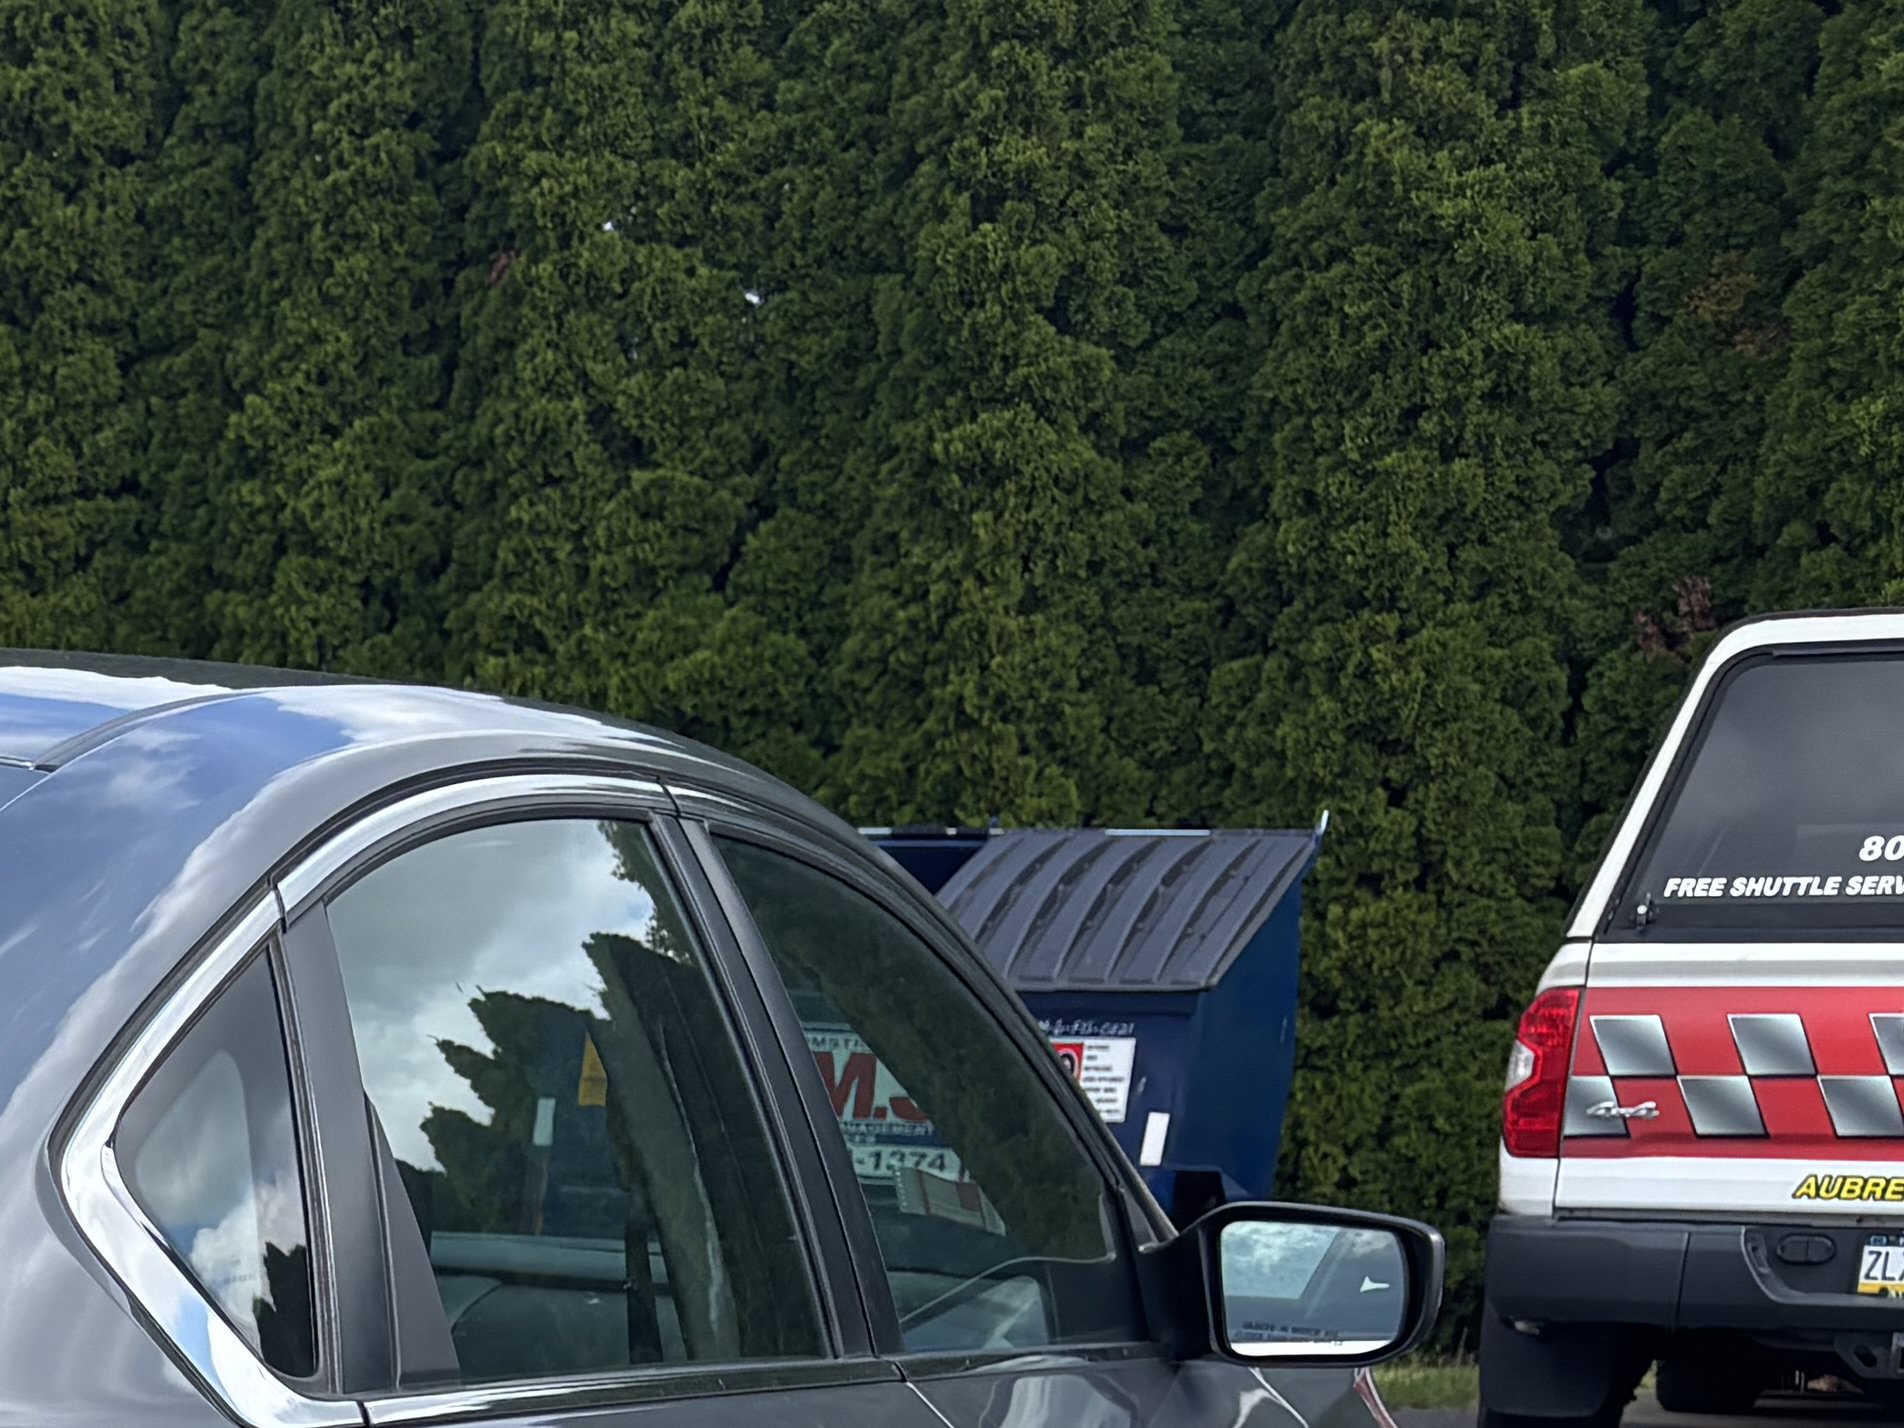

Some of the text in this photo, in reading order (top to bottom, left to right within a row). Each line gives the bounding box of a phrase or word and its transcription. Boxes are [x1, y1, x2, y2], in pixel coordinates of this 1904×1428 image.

[1663, 876, 1727, 898] FREE
[1729, 876, 1843, 898] SHUTTLE
[1792, 1174, 1904, 1201] AUBRE
